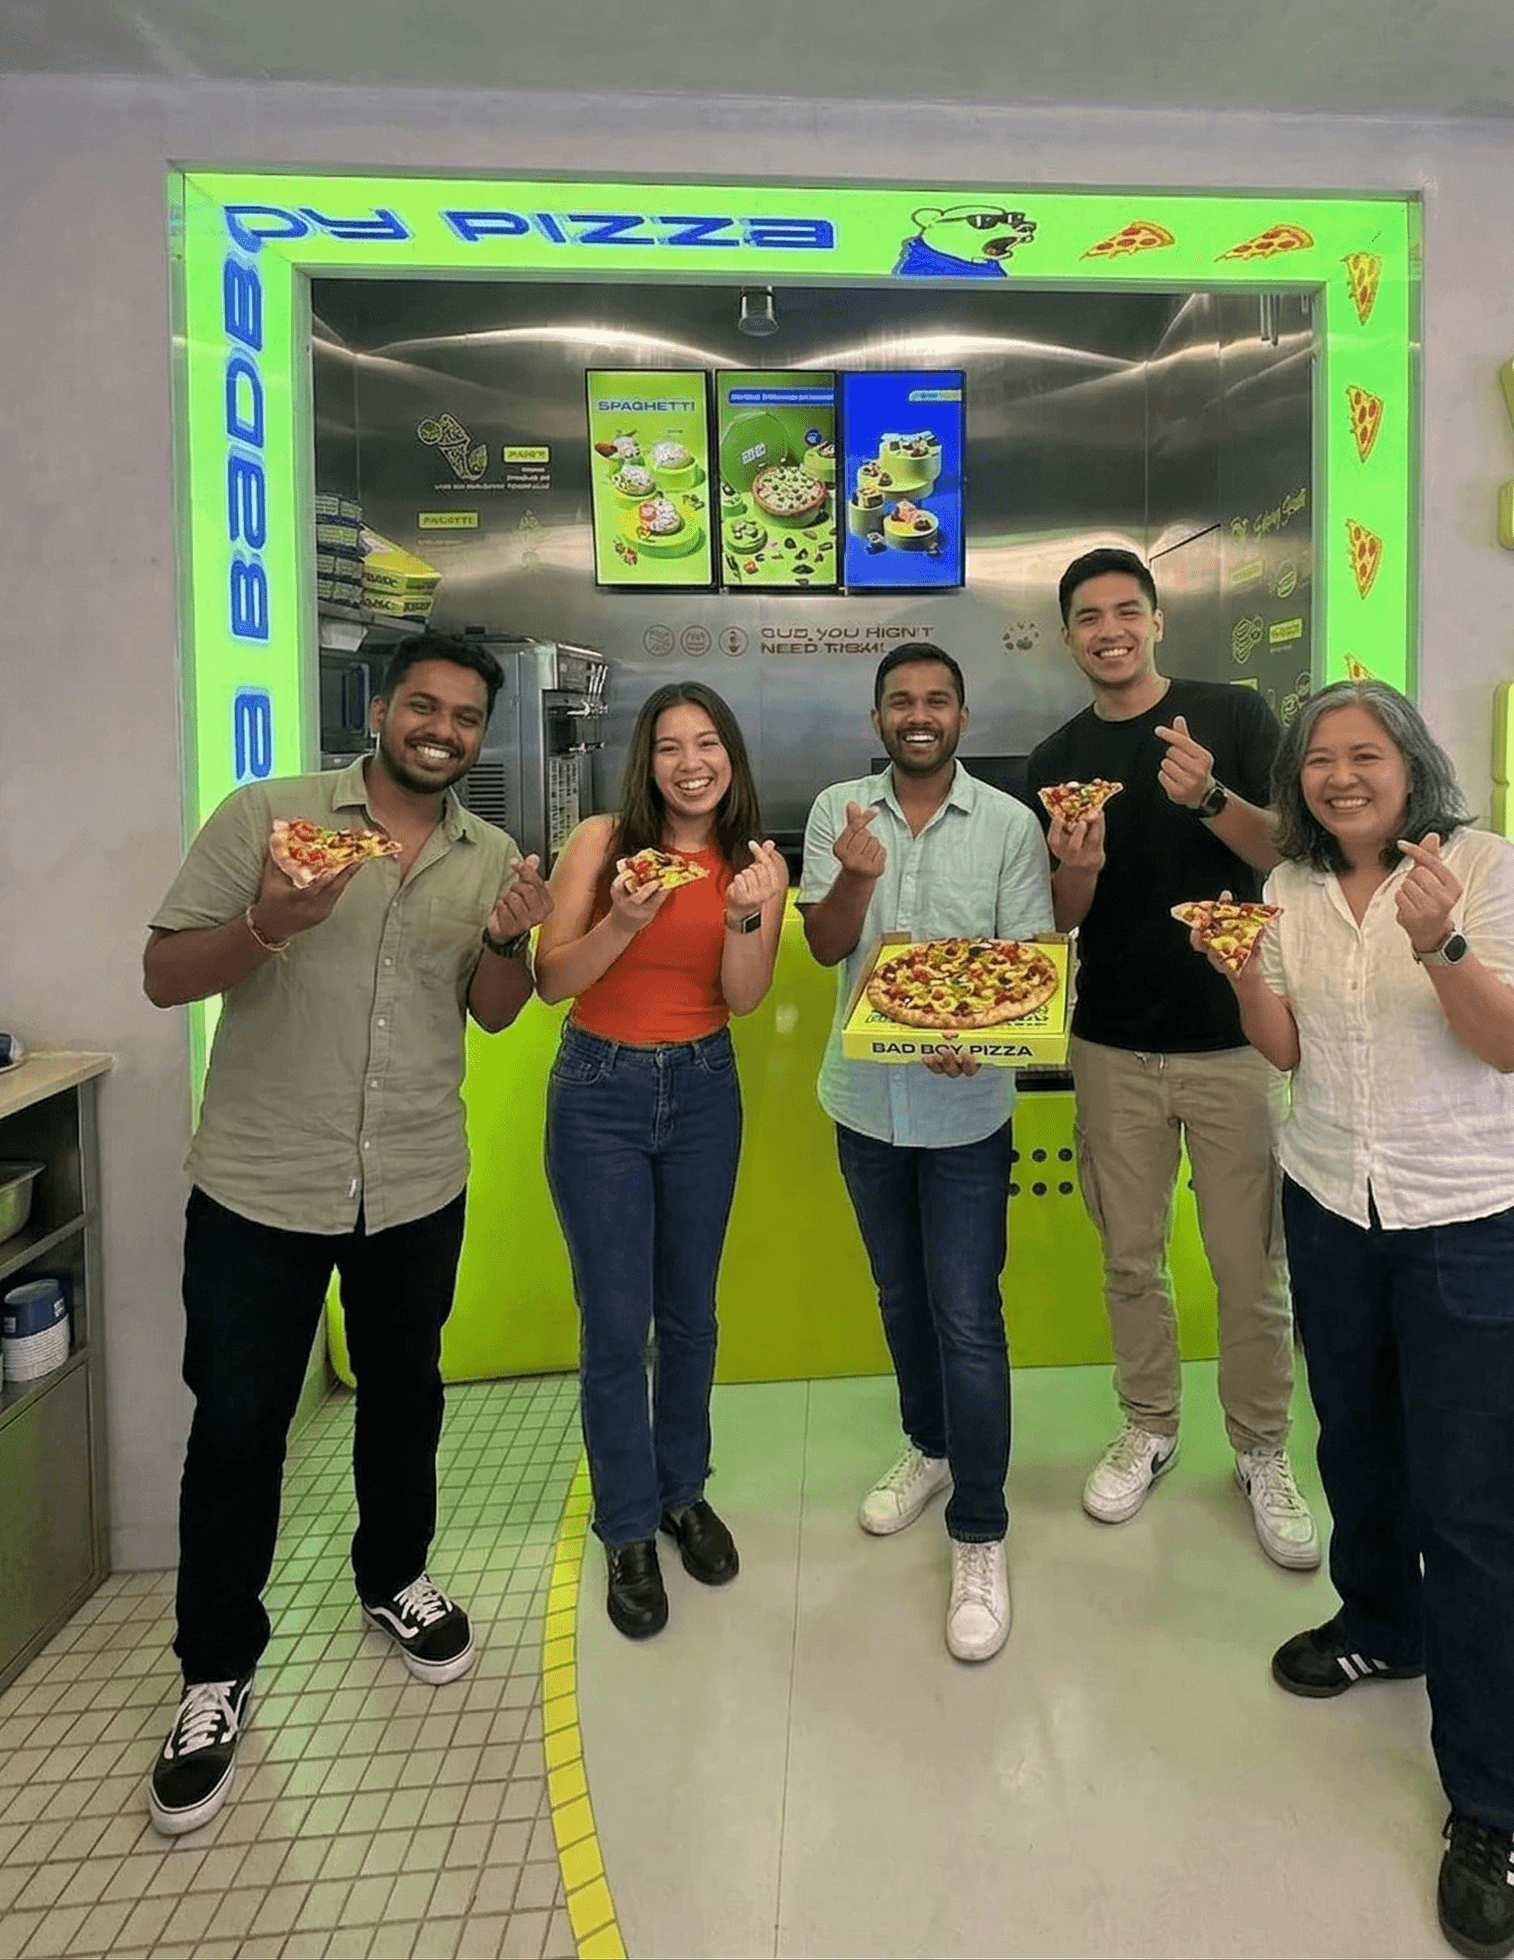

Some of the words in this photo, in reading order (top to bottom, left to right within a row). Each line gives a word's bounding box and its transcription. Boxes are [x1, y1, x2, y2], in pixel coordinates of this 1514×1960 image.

[761, 643, 818, 654] NEED
[872, 1042, 916, 1054] BAD
[920, 1043, 964, 1056] BOY
[969, 1044, 1033, 1057] PIZZA
